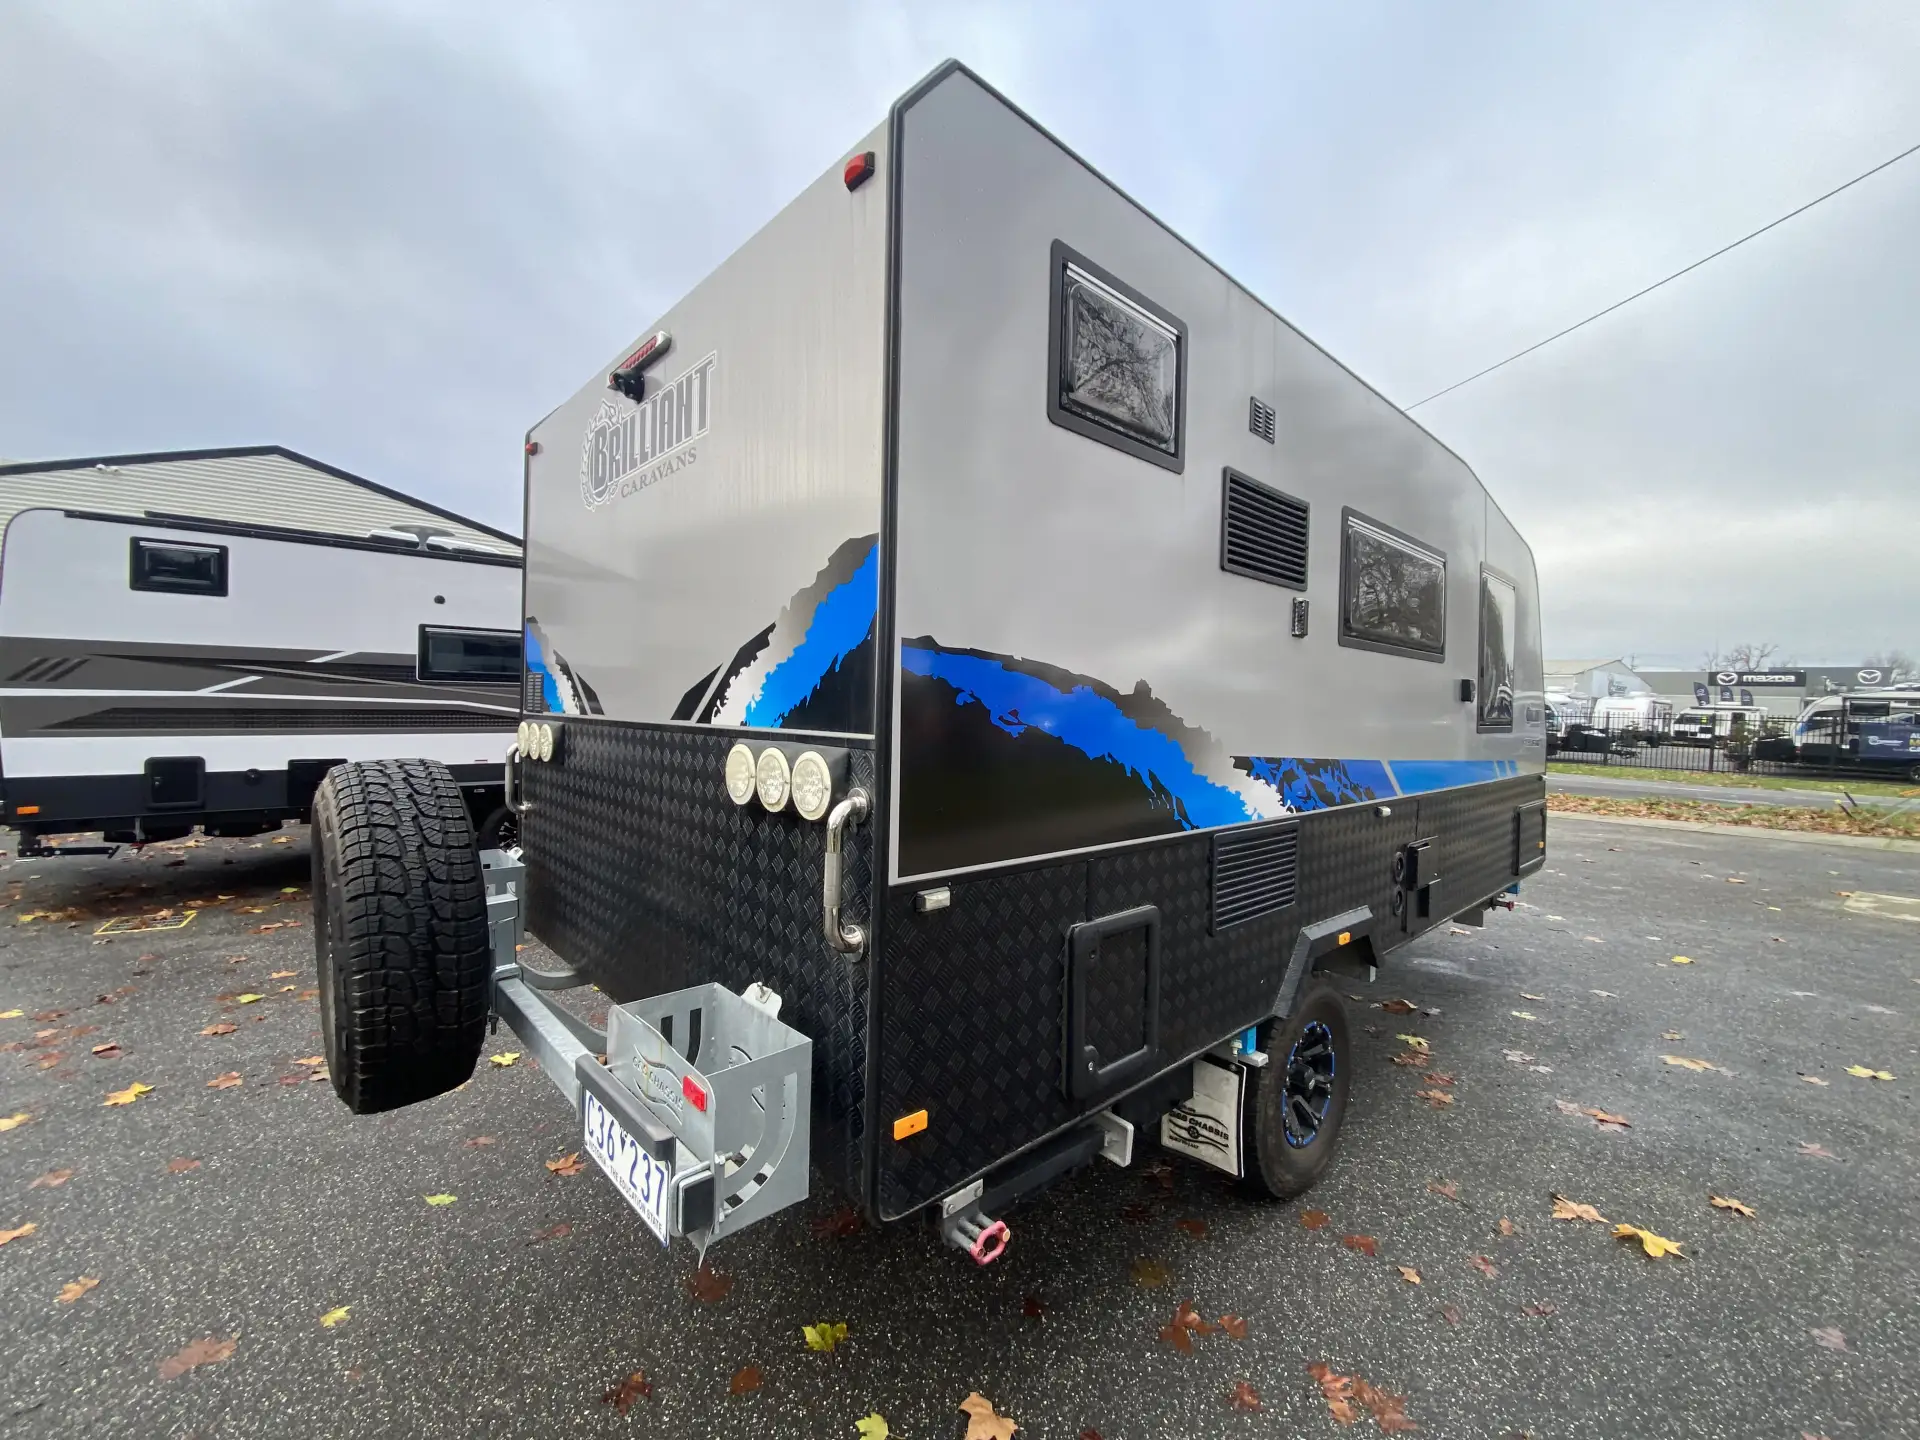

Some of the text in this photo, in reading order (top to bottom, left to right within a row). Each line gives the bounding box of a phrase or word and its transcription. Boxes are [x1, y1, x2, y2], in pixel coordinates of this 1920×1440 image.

[591, 351, 716, 494] BRILLIANT
[620, 446, 697, 498] CARAVANS
[649, 1071, 683, 1112] CHASSIS
[1188, 1117, 1229, 1140] CHASSIS
[619, 1176, 646, 1215] EDUCATION
[646, 1206, 664, 1236] STATE
